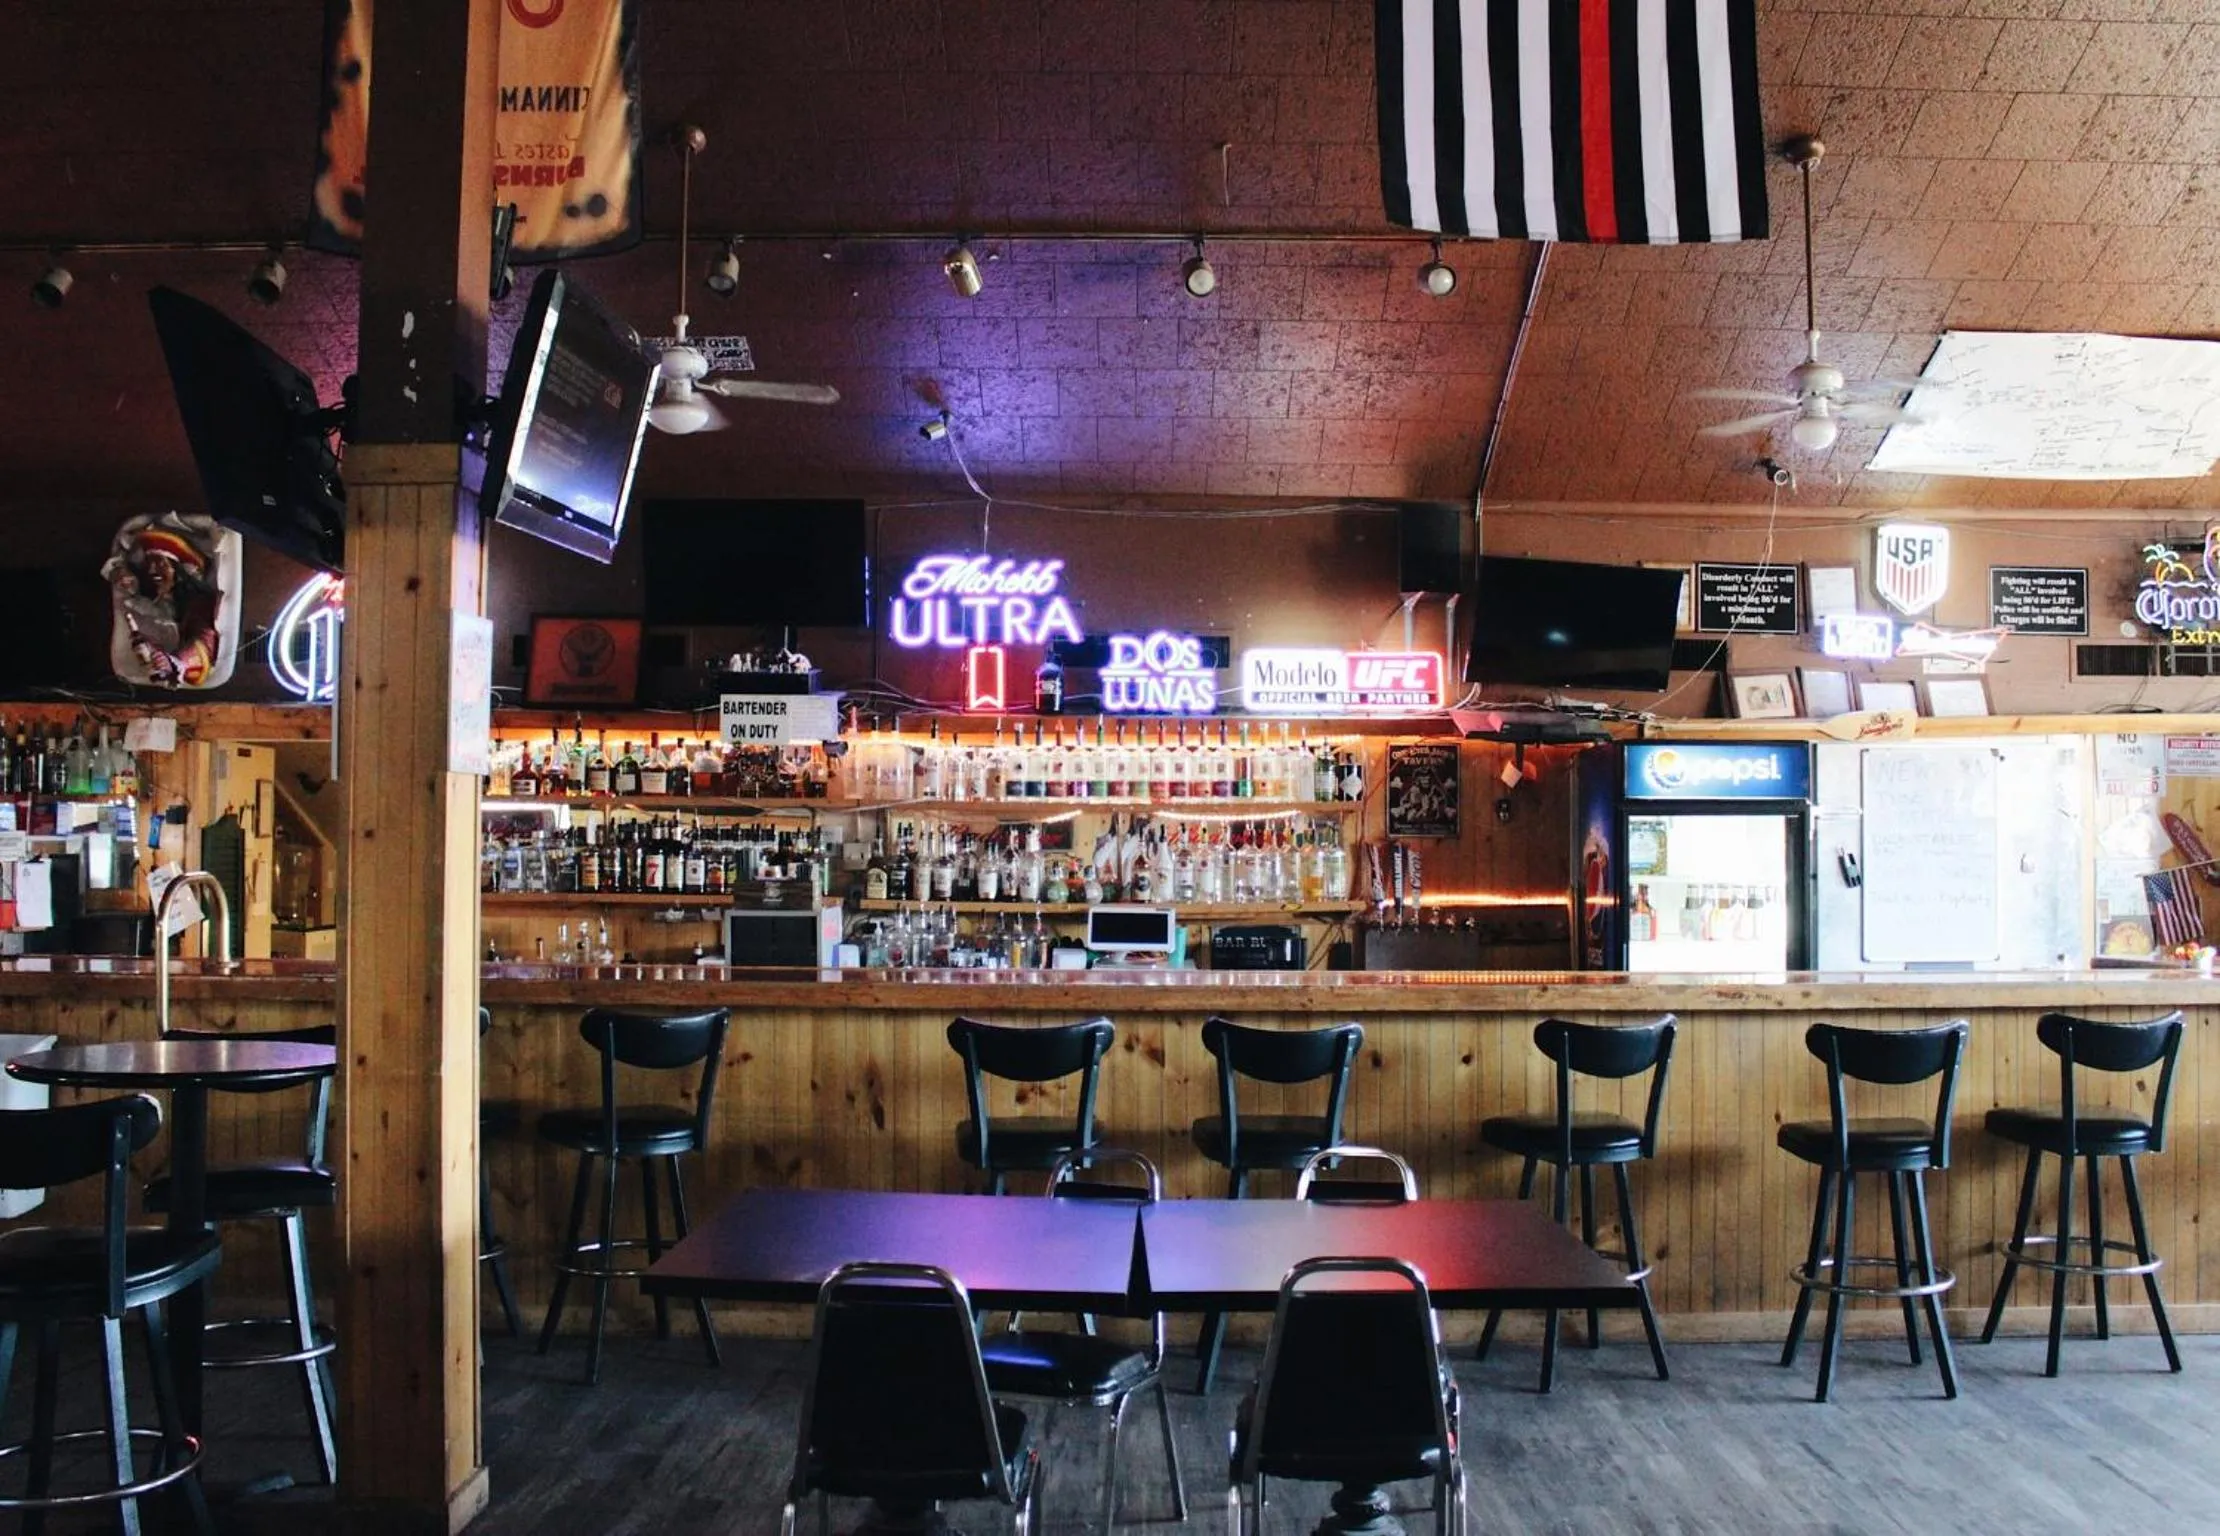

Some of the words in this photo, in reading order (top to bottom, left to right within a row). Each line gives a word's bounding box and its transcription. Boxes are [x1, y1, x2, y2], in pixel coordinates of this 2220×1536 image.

[1887, 535, 1933, 565] USA
[903, 554, 1065, 599] Michelob
[1702, 573, 1742, 583] Disorderly
[1745, 574, 1777, 582] Conduct
[1780, 575, 1794, 583] will
[2001, 576, 2031, 586] Fighting
[2010, 586, 2036, 594] "ALL"
[2037, 587, 2067, 595] involved
[1704, 594, 1736, 602] involved
[1738, 595, 1760, 604] being
[1780, 595, 1792, 603] for
[2002, 596, 2022, 605] being
[2040, 596, 2051, 604] for
[1727, 605, 1765, 613] minimum
[1767, 605, 1776, 613] of
[1994, 605, 2015, 613] Police
[2041, 606, 2069, 614] notified
[893, 596, 1084, 647] ULTRA
[2001, 615, 2030, 625] Charges
[2032, 615, 2045, 624] will
[2046, 615, 2054, 624] be
[1108, 631, 1202, 673] DOS
[1254, 660, 1337, 686] Modelo
[1354, 660, 1429, 688] UFC
[1101, 676, 1216, 711] LUNAS
[1259, 692, 1316, 704] OFFICIAL
[1326, 692, 1361, 704] BEER
[1367, 693, 1430, 704] PARTNER
[723, 701, 787, 715] BARTENDER
[731, 724, 746, 738] ON
[749, 724, 778, 738] DUTY
[1690, 753, 1777, 786] pepsi
[647, 860, 659, 885] 7
